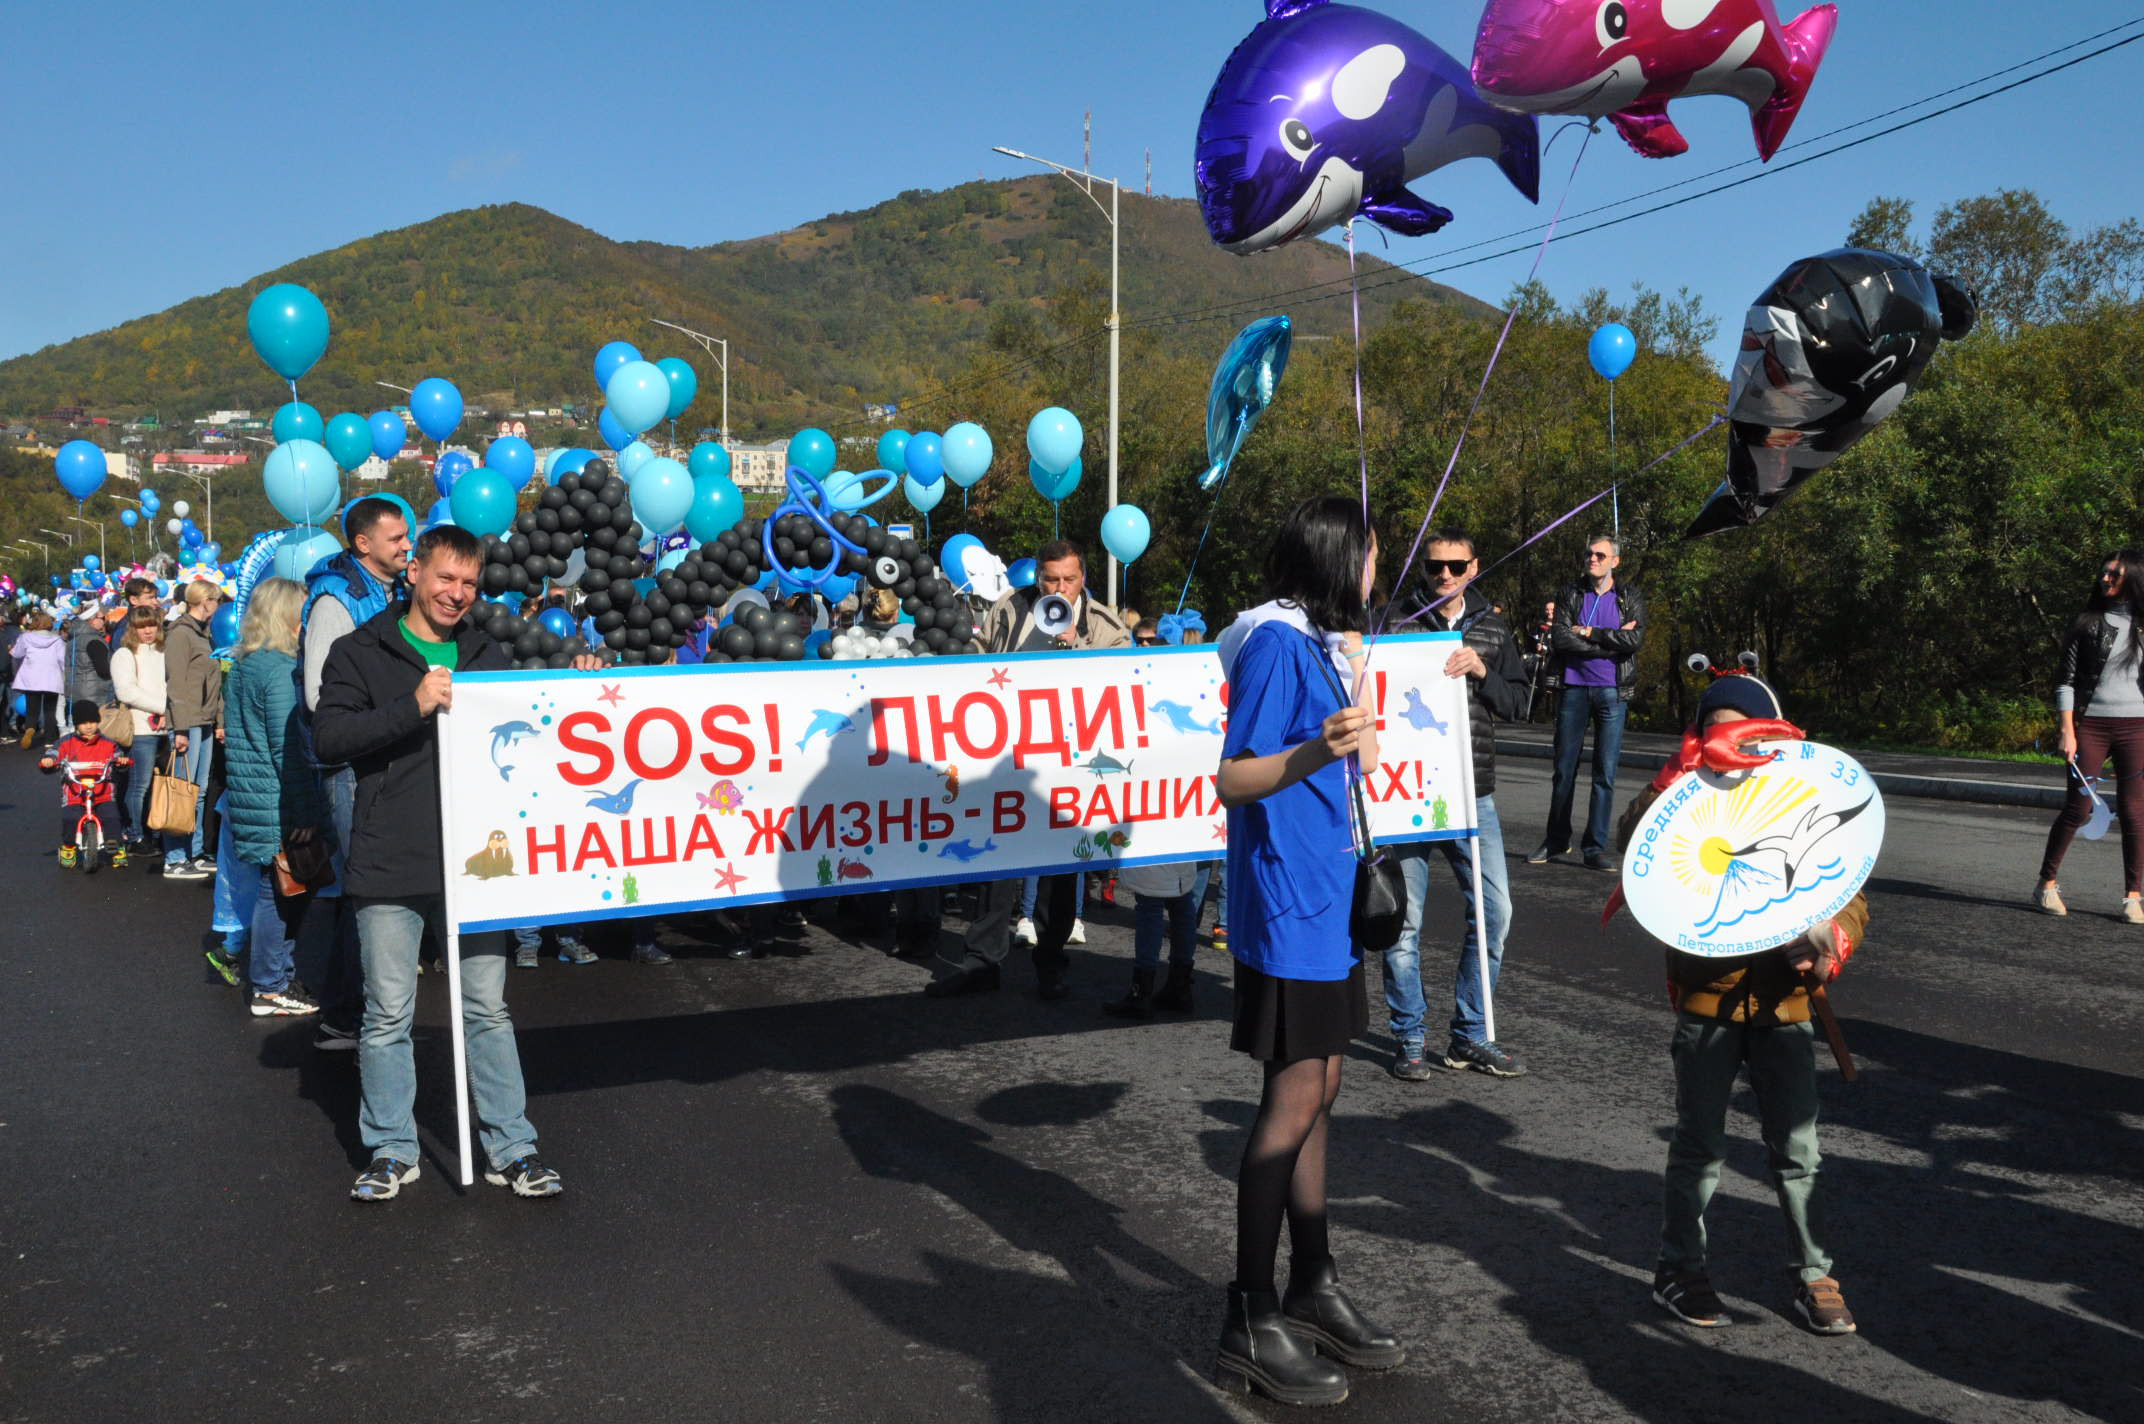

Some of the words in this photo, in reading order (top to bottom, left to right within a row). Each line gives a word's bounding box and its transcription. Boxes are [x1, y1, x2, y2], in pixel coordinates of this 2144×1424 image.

[555, 702, 784, 787] SOS!
[868, 684, 1150, 768] ЛЮДИ!
[526, 813, 726, 875] НАША
[1632, 777, 1702, 878] Средняя
[1830, 760, 1860, 787] 33
